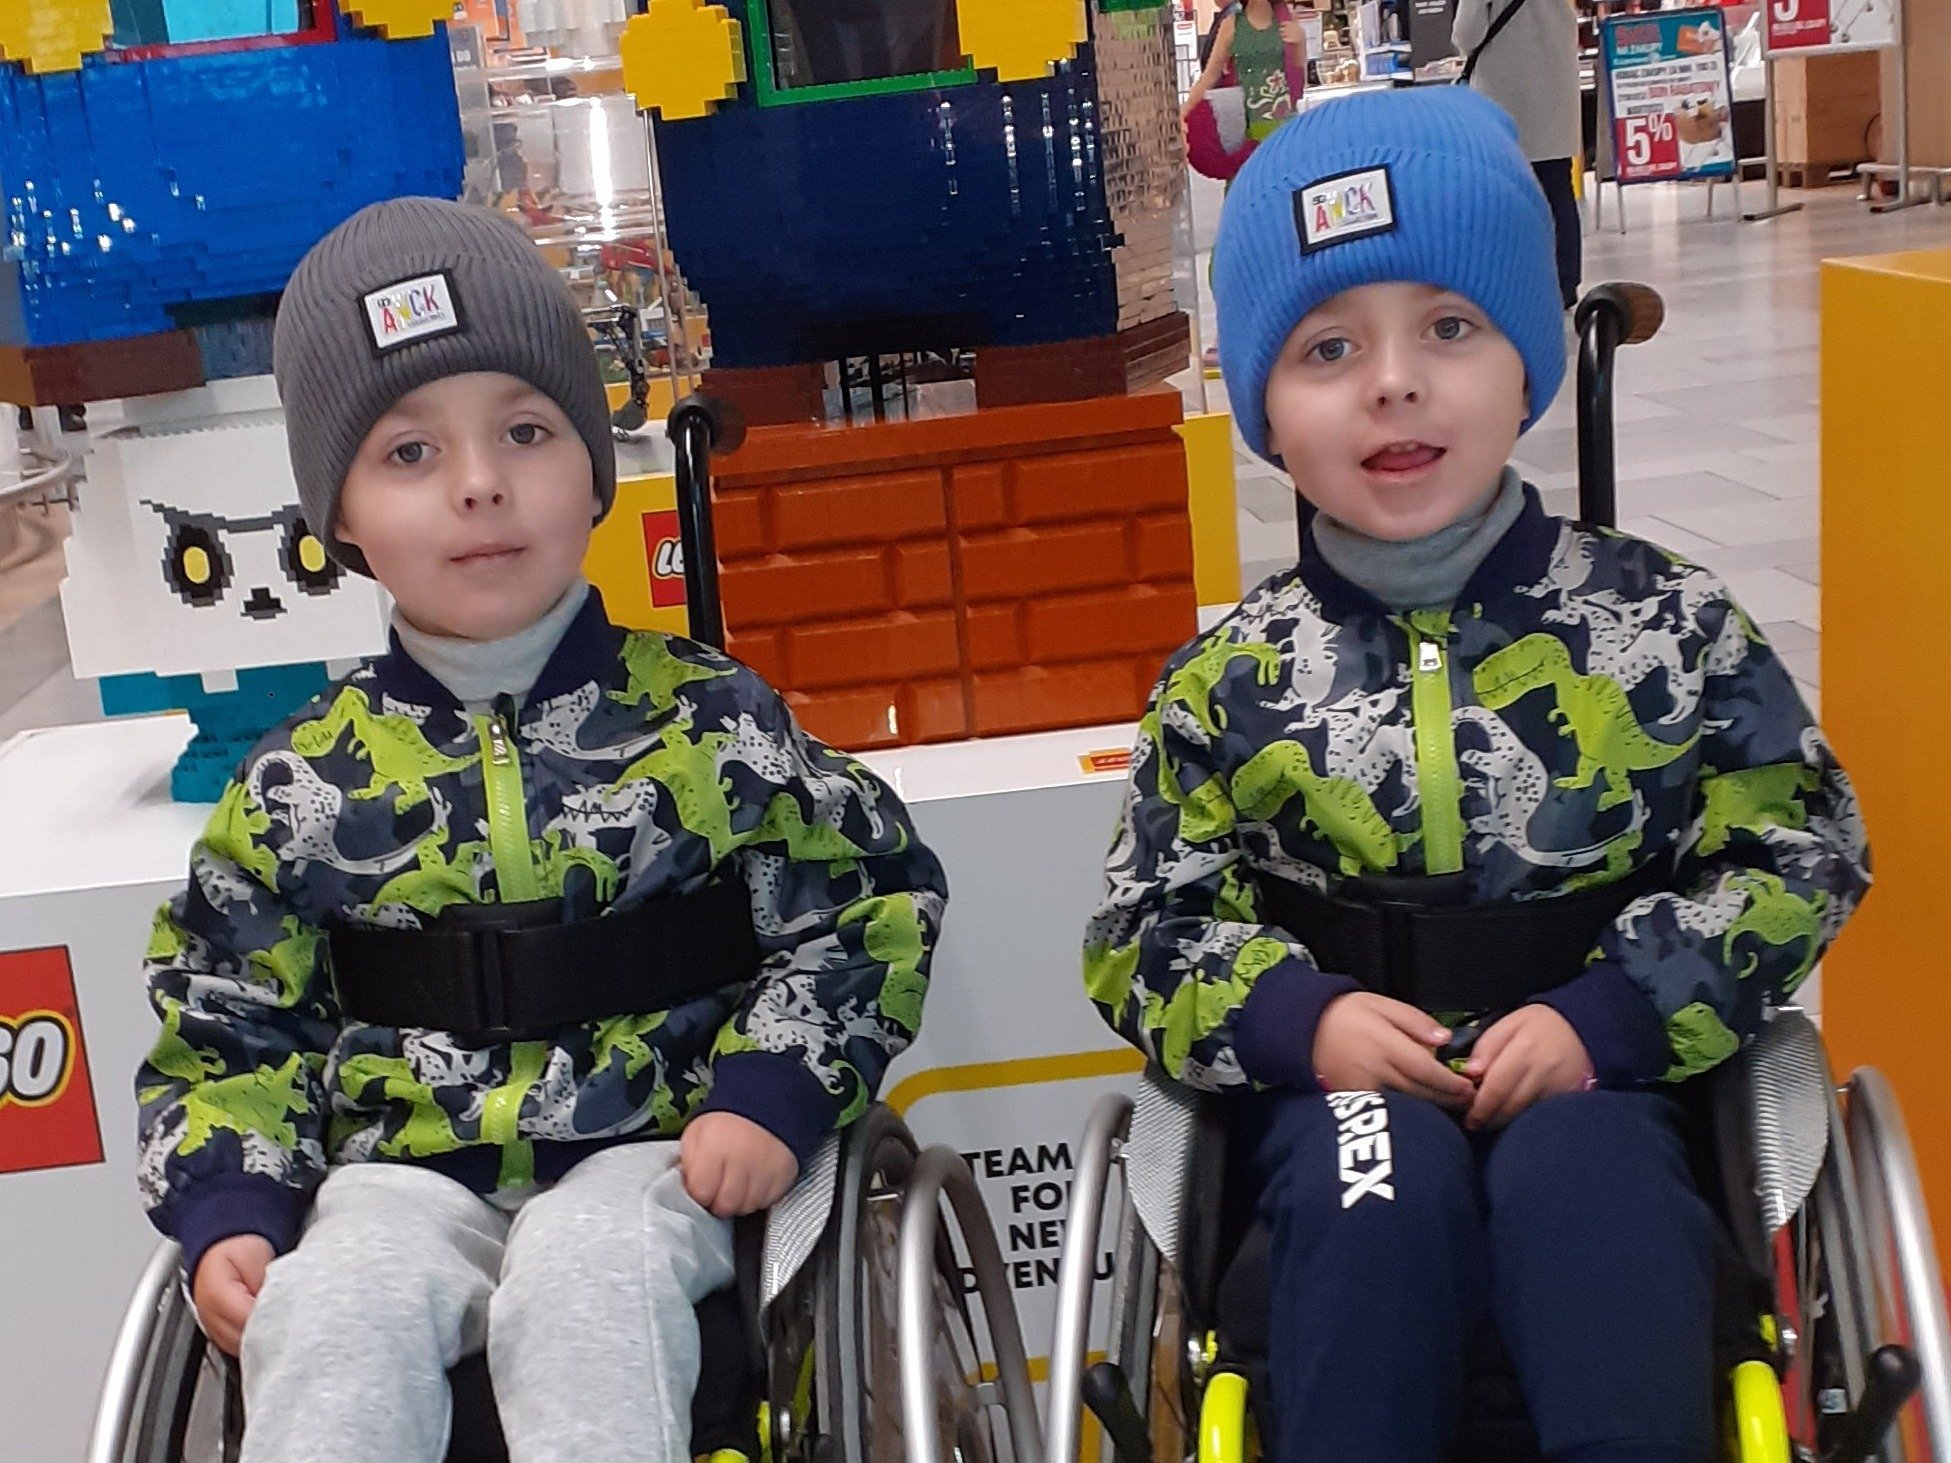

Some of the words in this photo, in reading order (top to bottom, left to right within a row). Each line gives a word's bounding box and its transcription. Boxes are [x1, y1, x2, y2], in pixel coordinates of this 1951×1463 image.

[1625, 112, 1674, 165] 5%
[960, 1142, 1074, 1178] TEAM
[1010, 1180, 1072, 1214] FO
[1009, 1218, 1066, 1251] NE
